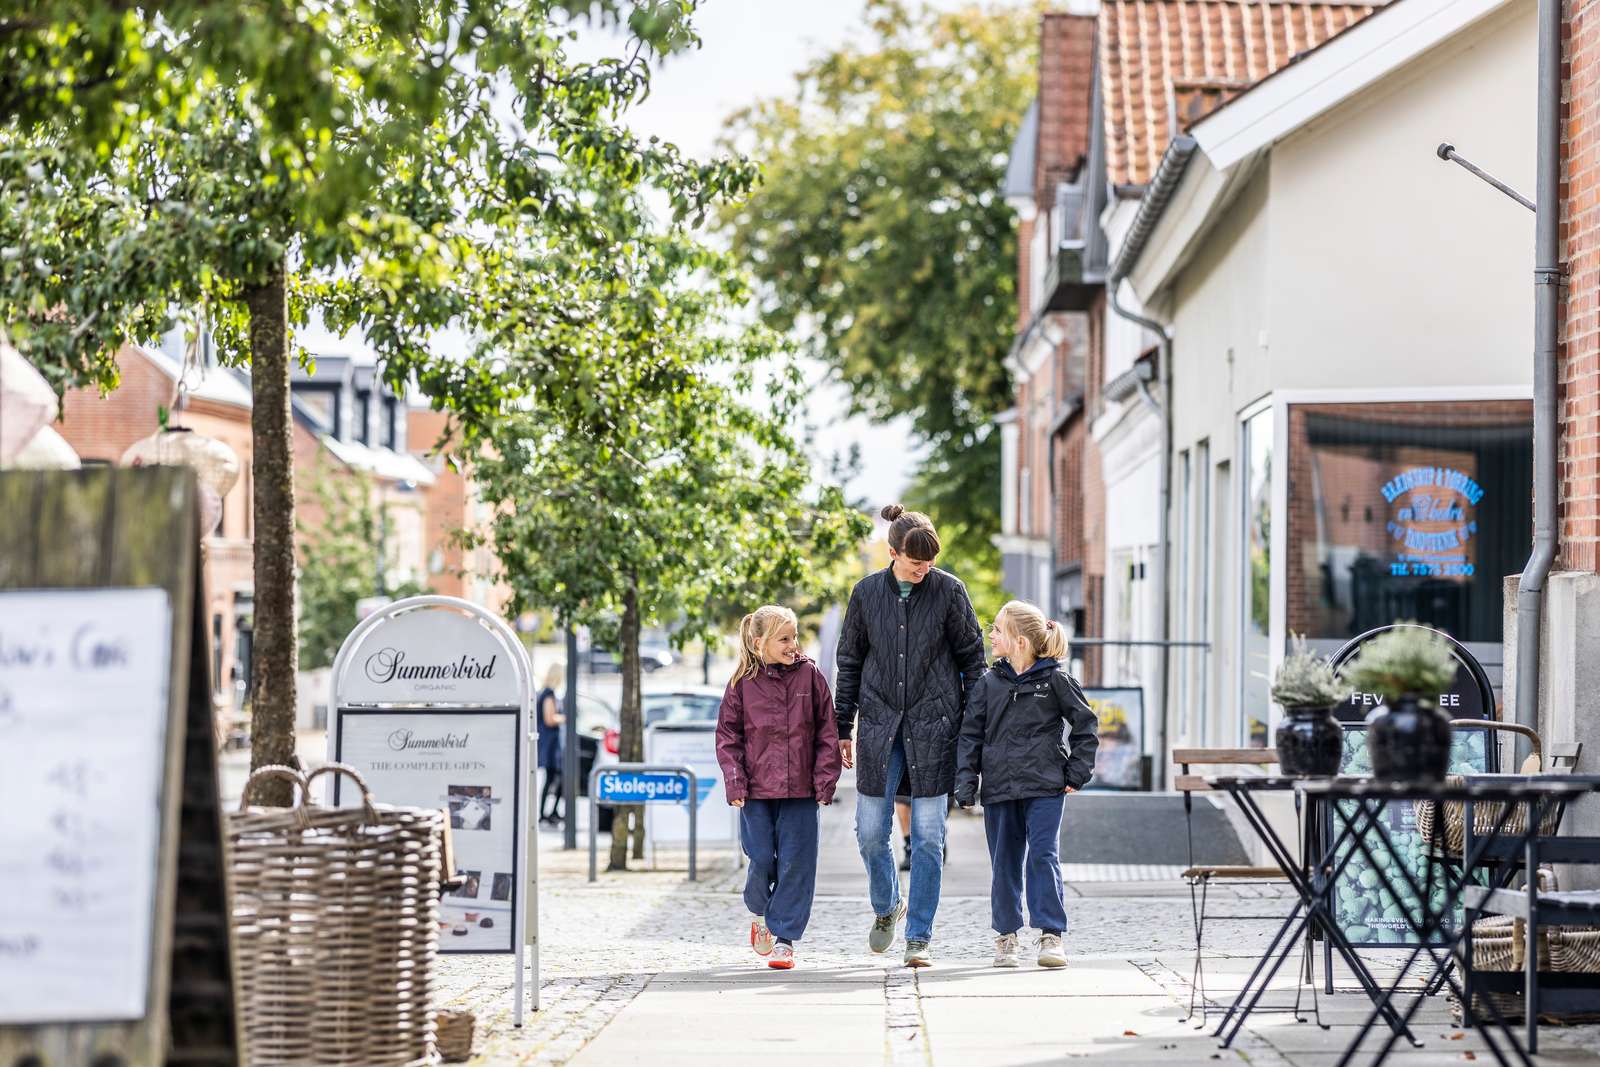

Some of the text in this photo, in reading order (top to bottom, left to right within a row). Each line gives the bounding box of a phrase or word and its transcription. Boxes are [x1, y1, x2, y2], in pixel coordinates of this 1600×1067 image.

[364, 647, 497, 684] Summerbird
[387, 728, 470, 752] Summerbird
[370, 761, 486, 771] THE COMPLETE GIFTS
[604, 776, 683, 798] Skolegade
